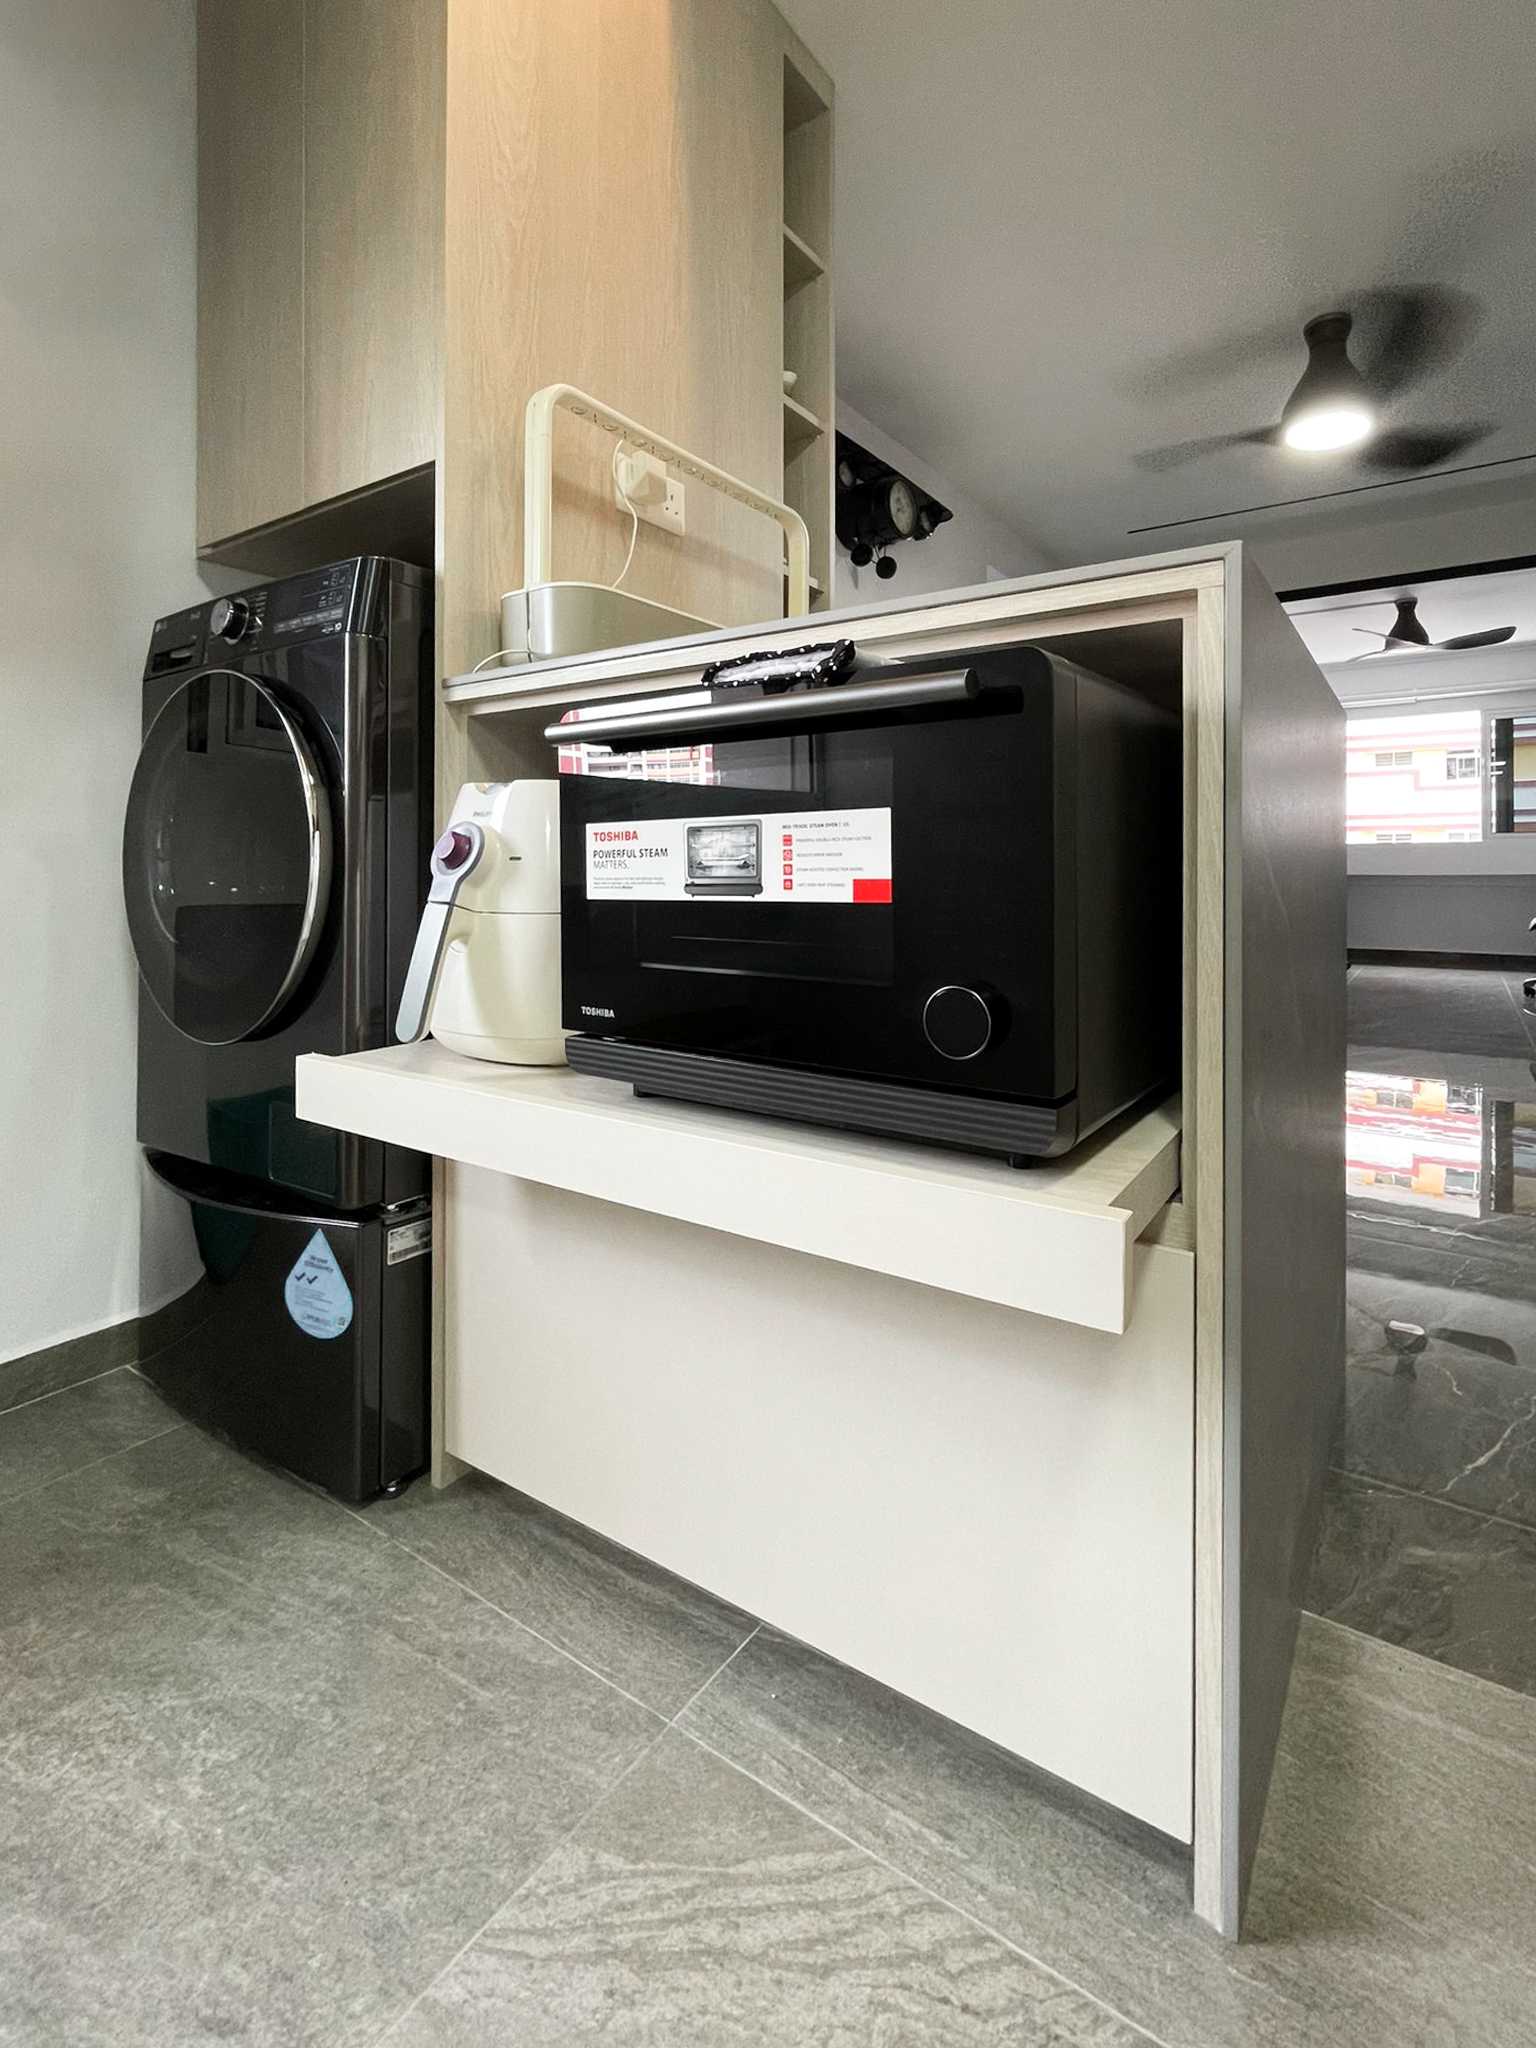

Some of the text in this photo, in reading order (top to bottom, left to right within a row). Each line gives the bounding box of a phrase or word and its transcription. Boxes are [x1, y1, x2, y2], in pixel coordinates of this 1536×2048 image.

[593, 830, 639, 842] TOSHIBA
[593, 848, 669, 859] POWERFUL STEAM
[593, 860, 630, 870] MATTERS.
[581, 1005, 616, 1018] TOSHIBA
